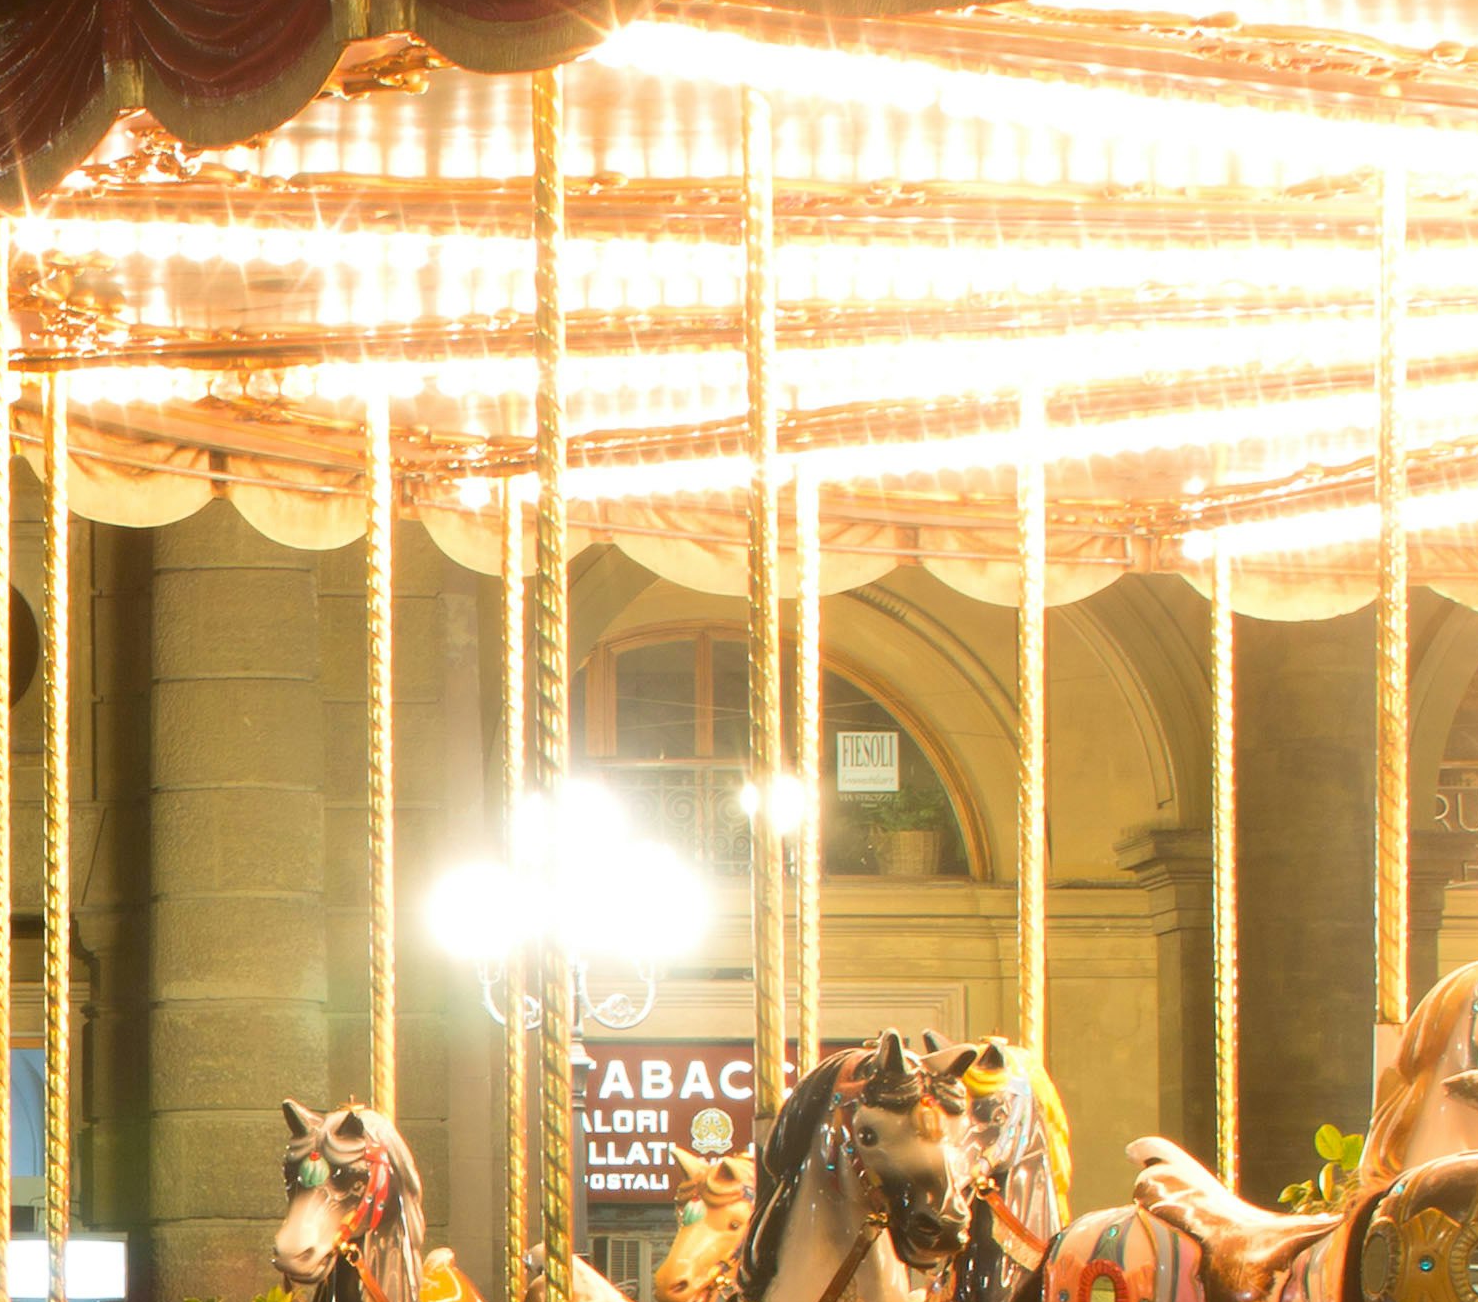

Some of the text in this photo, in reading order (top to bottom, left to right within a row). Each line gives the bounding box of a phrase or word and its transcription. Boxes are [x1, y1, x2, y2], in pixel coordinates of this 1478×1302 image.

[842, 734, 894, 768] FIESOLI
[587, 1060, 795, 1100] ABAC
[582, 1110, 669, 1133] LORI
[588, 1141, 676, 1166] LLATI
